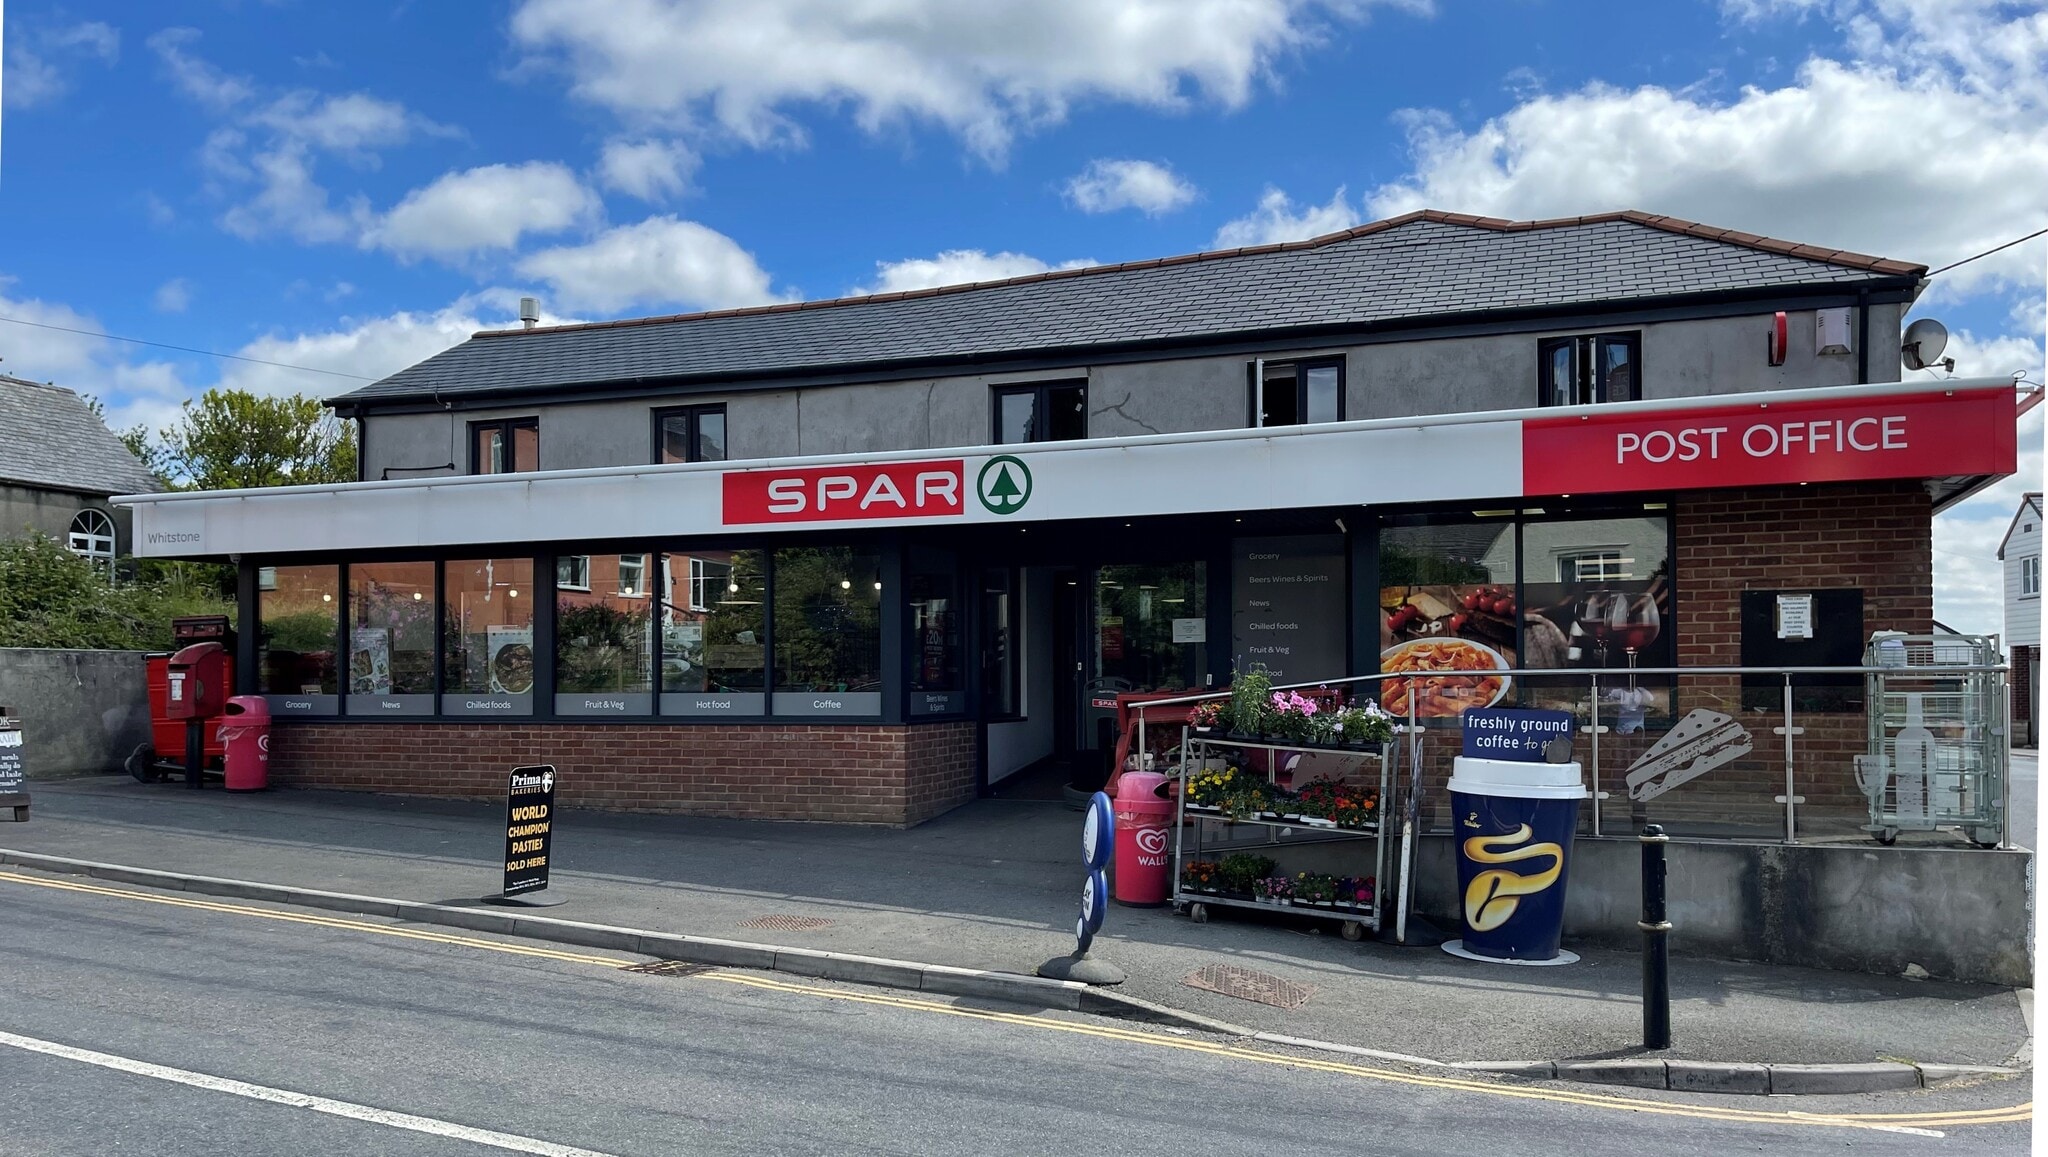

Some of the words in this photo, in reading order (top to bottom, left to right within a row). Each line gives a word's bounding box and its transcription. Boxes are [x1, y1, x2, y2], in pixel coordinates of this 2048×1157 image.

[1617, 426, 1728, 464] POST
[1742, 415, 1908, 458] OFFICE
[768, 470, 958, 514] SPAR
[147, 532, 200, 544] Whitstone
[1249, 552, 1280, 561] Grocery
[1272, 575, 1296, 583] Wines
[1303, 574, 1328, 583] Spirits
[1249, 622, 1276, 630] Chilled
[1276, 622, 1299, 630] foods
[1249, 646, 1267, 654] Fruit
[1267, 646, 1274, 654] &
[1275, 646, 1290, 655] Veg
[285, 700, 312, 710] Grocery
[382, 701, 400, 709] News
[466, 700, 490, 709] Chilled
[491, 700, 511, 709] foods
[585, 700, 602, 709] Fruit
[602, 701, 610, 709] &
[610, 700, 625, 710] Veg
[696, 700, 711, 709] Hot
[711, 700, 730, 709] food
[813, 700, 842, 709] Coffee
[1468, 715, 1516, 732] freshly
[1520, 719, 1568, 732] ground
[1476, 735, 1519, 748] coffee
[1523, 736, 1538, 750] to
[511, 773, 541, 787] Prima
[511, 787, 541, 796] BAKERIES
[512, 804, 548, 822] WORLD
[512, 838, 543, 855] PASTIES
[506, 859, 526, 872] SOLD
[526, 856, 546, 869] HERE
[1137, 855, 1168, 867] WALL'S
